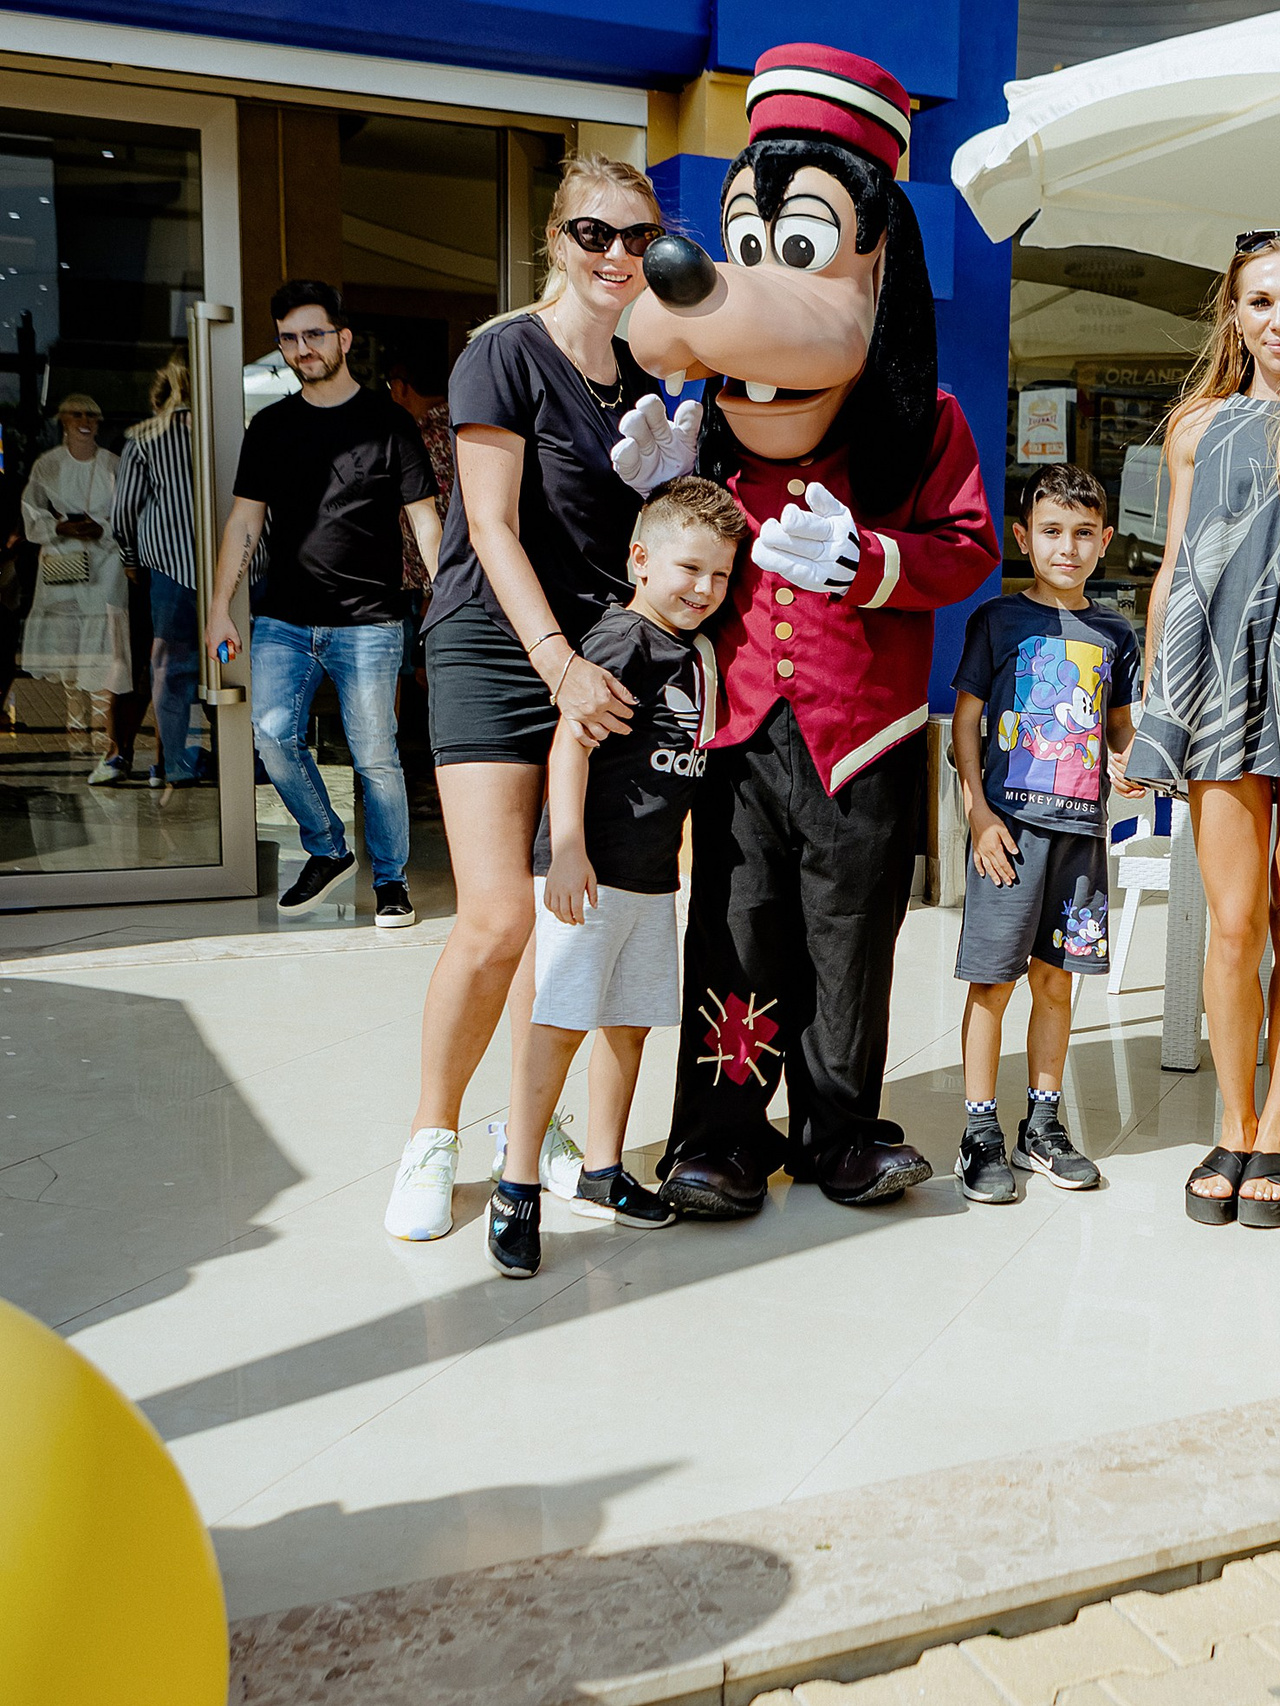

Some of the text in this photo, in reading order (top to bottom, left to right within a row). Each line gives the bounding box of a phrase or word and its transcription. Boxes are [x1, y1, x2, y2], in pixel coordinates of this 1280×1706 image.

[1105, 367, 1187, 385] ORLAND
[650, 748, 708, 778] adid
[1005, 791, 1096, 814] MICKEY MOUSE
